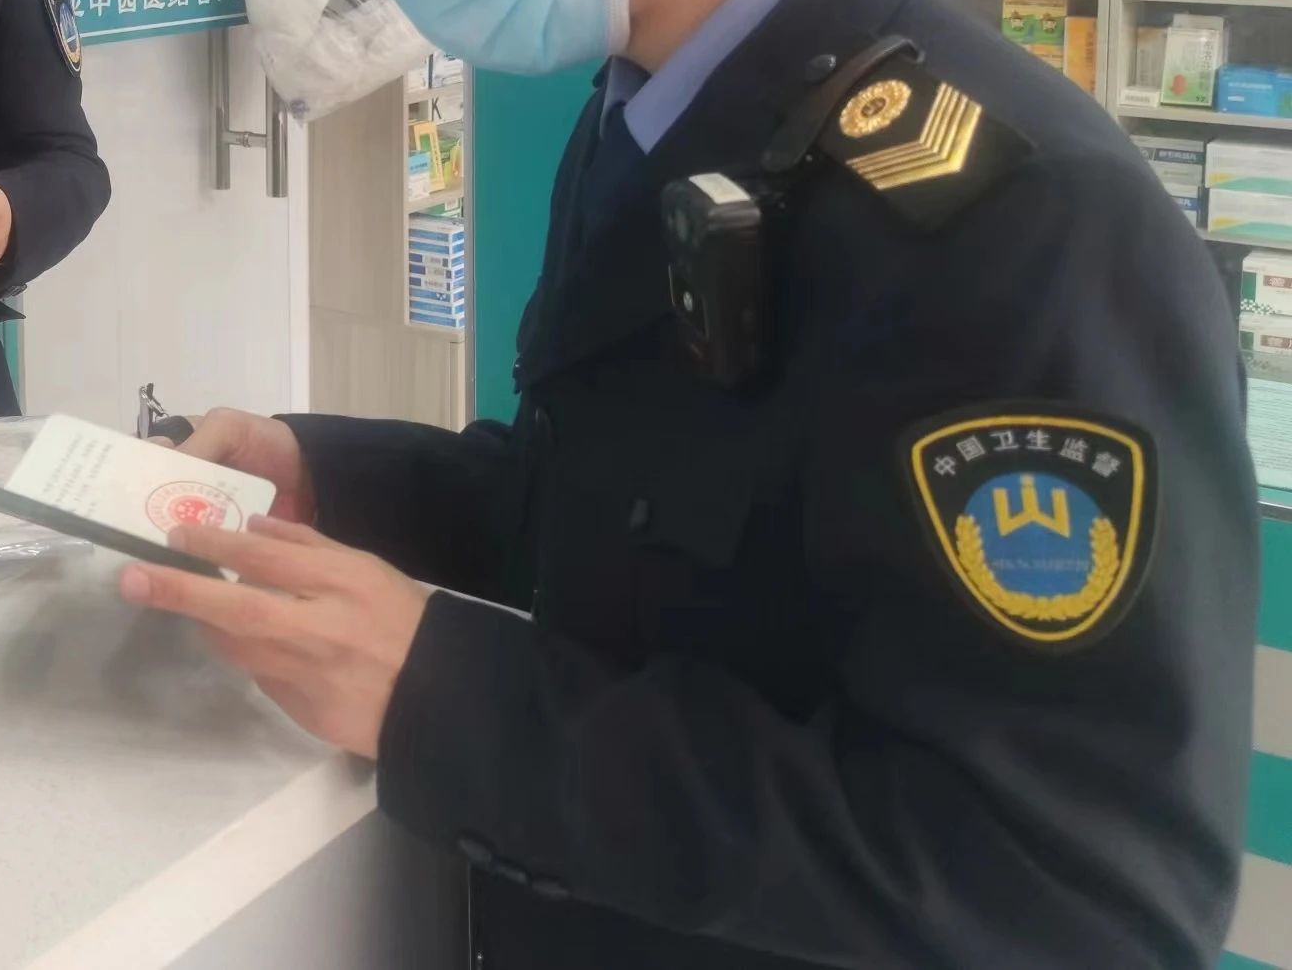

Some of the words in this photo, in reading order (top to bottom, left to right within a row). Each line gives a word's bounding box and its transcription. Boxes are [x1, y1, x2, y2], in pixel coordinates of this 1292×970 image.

[933, 429, 1123, 479] 中国卫生监督
